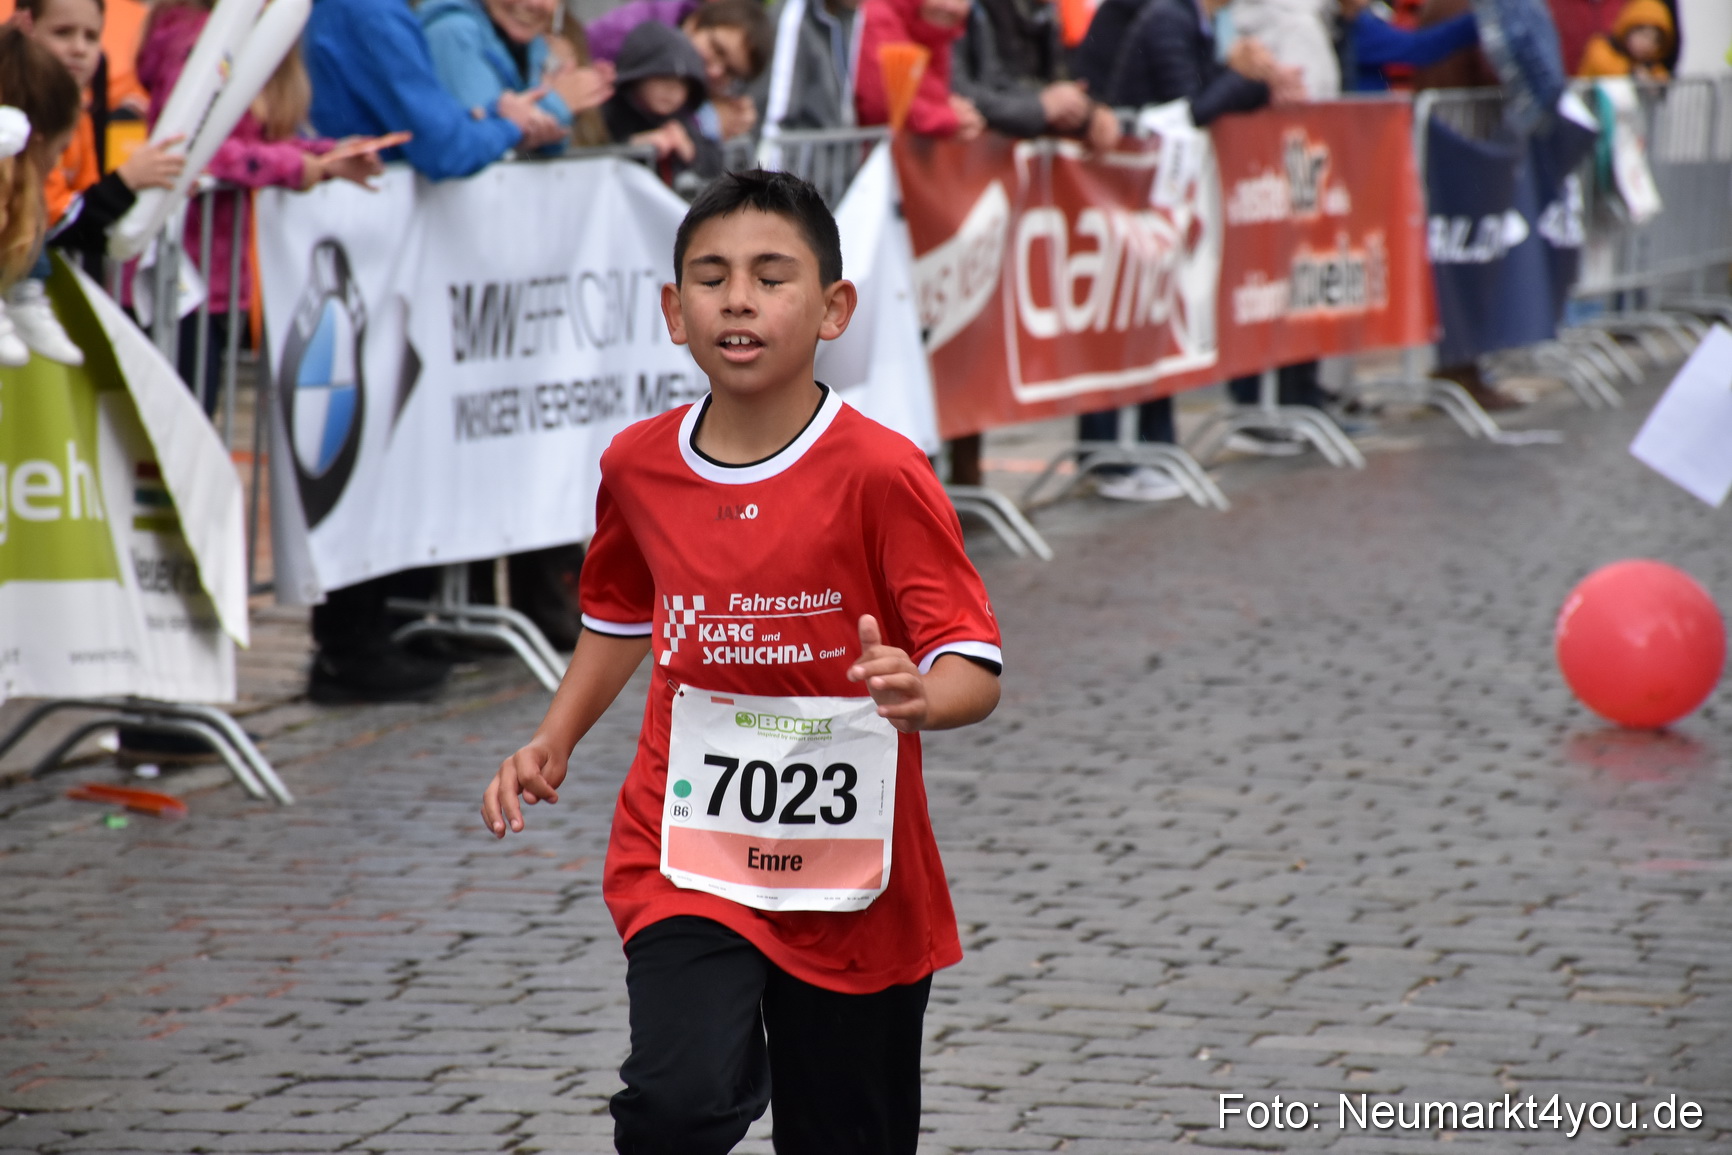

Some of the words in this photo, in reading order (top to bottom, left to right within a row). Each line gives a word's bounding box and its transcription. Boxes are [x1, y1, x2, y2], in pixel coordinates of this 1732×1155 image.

[728, 588, 842, 612] Fahrschule
[698, 623, 754, 643] KARG
[761, 632, 781, 642] und
[819, 646, 846, 660] GmbH
[757, 713, 833, 735] BOCK
[703, 753, 858, 825] 7023
[673, 805, 689, 818] B6
[747, 846, 803, 872] Emre
